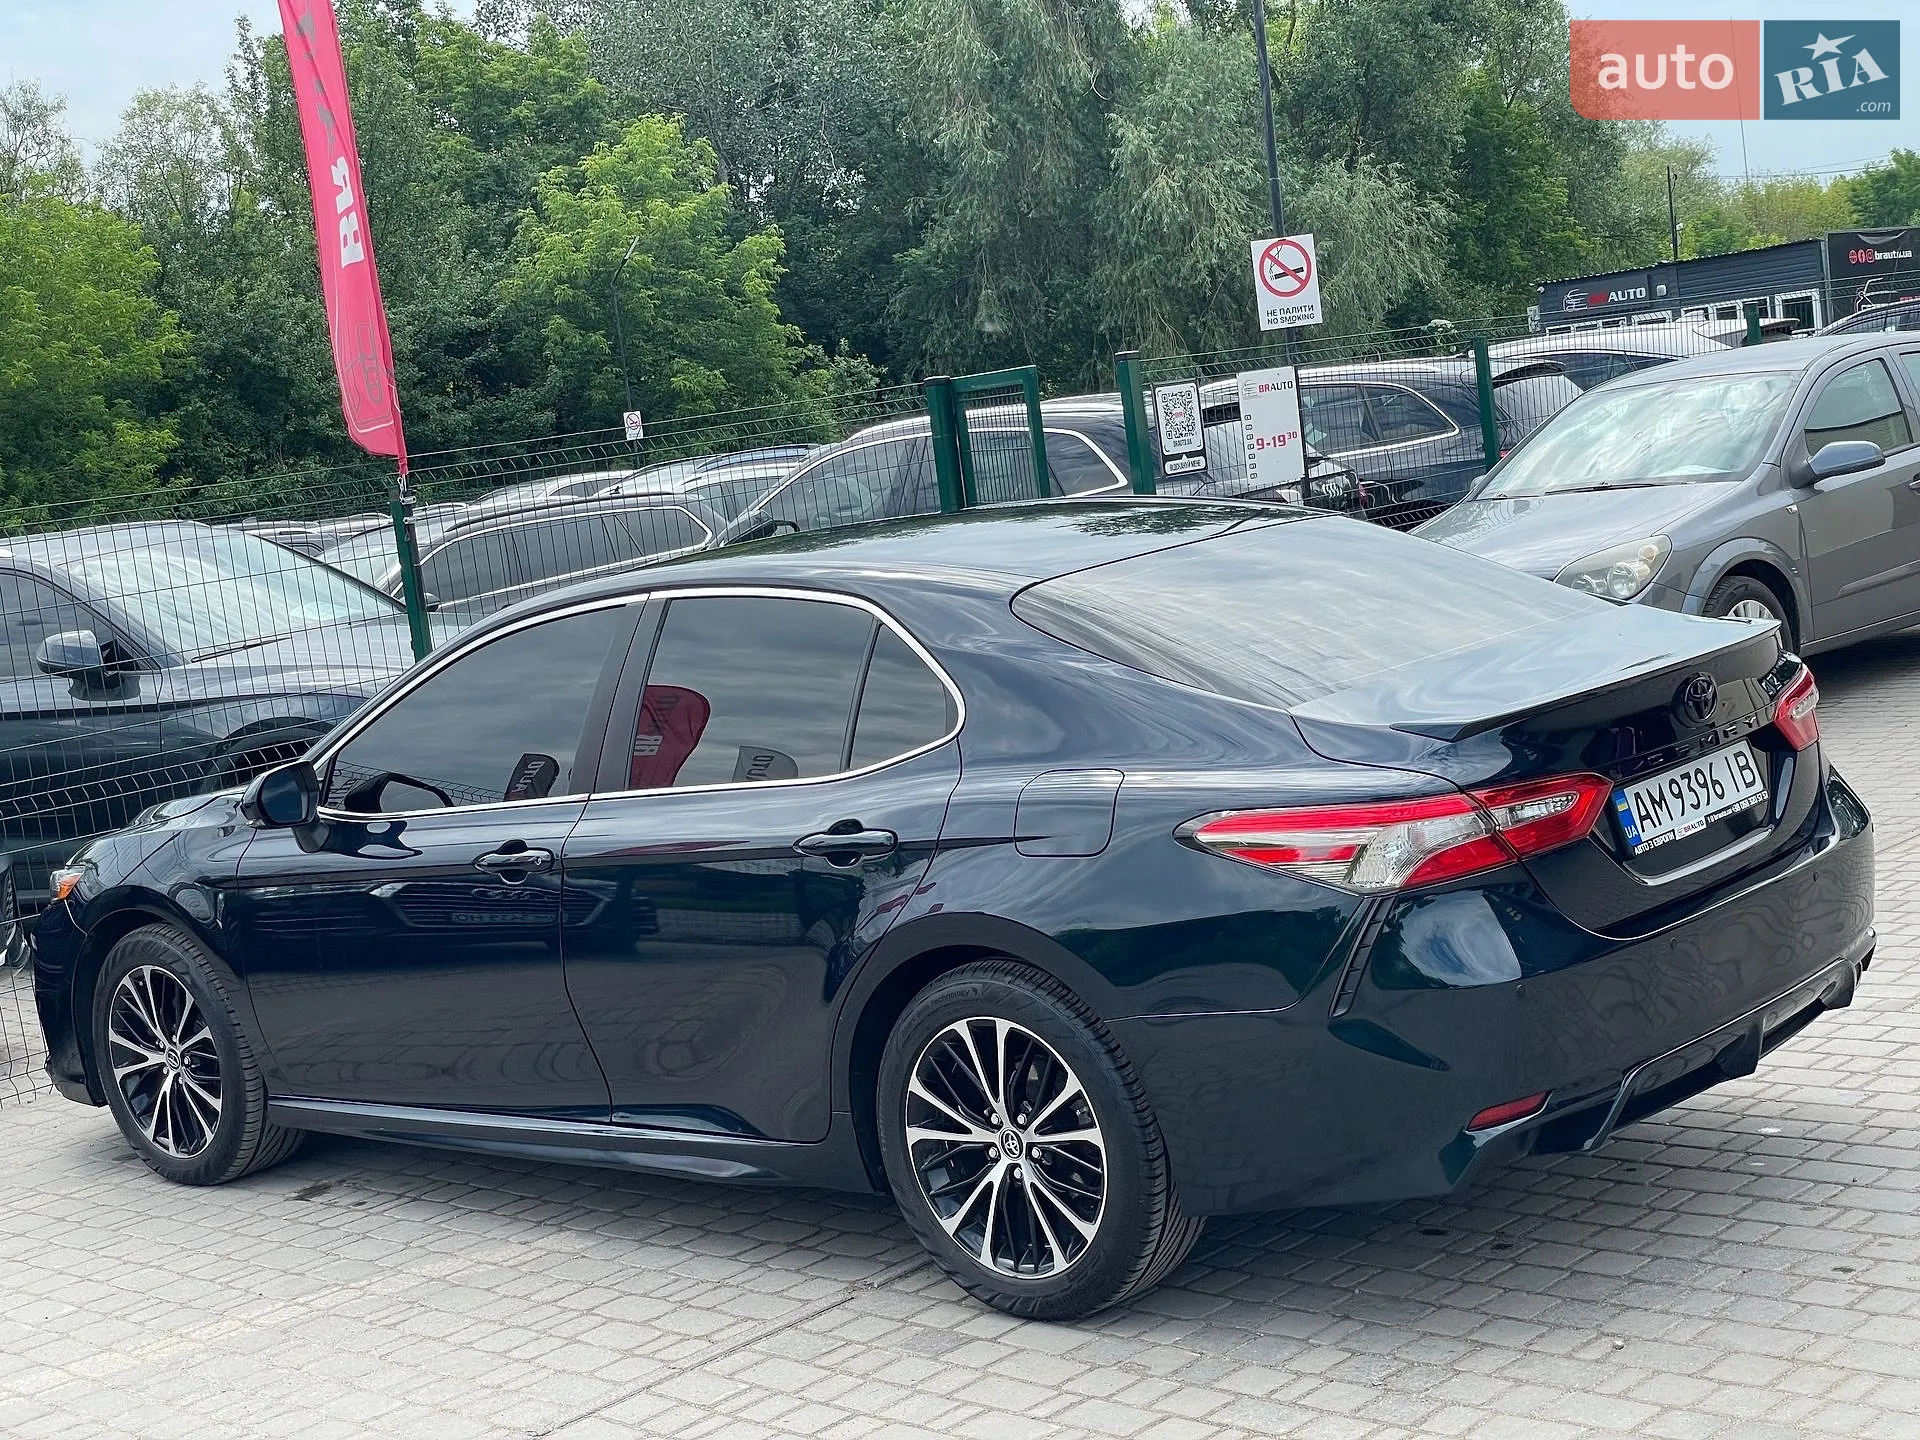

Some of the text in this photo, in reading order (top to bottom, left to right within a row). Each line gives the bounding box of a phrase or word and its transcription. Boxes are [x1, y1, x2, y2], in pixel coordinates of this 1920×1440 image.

[1587, 287, 1646, 305] AUTO
[1266, 304, 1314, 317] НЕ ПАЛИТИ
[1267, 312, 1315, 325] NO SMOKING
[1258, 380, 1293, 393] BRAUTO
[1625, 825, 1639, 839] UA
